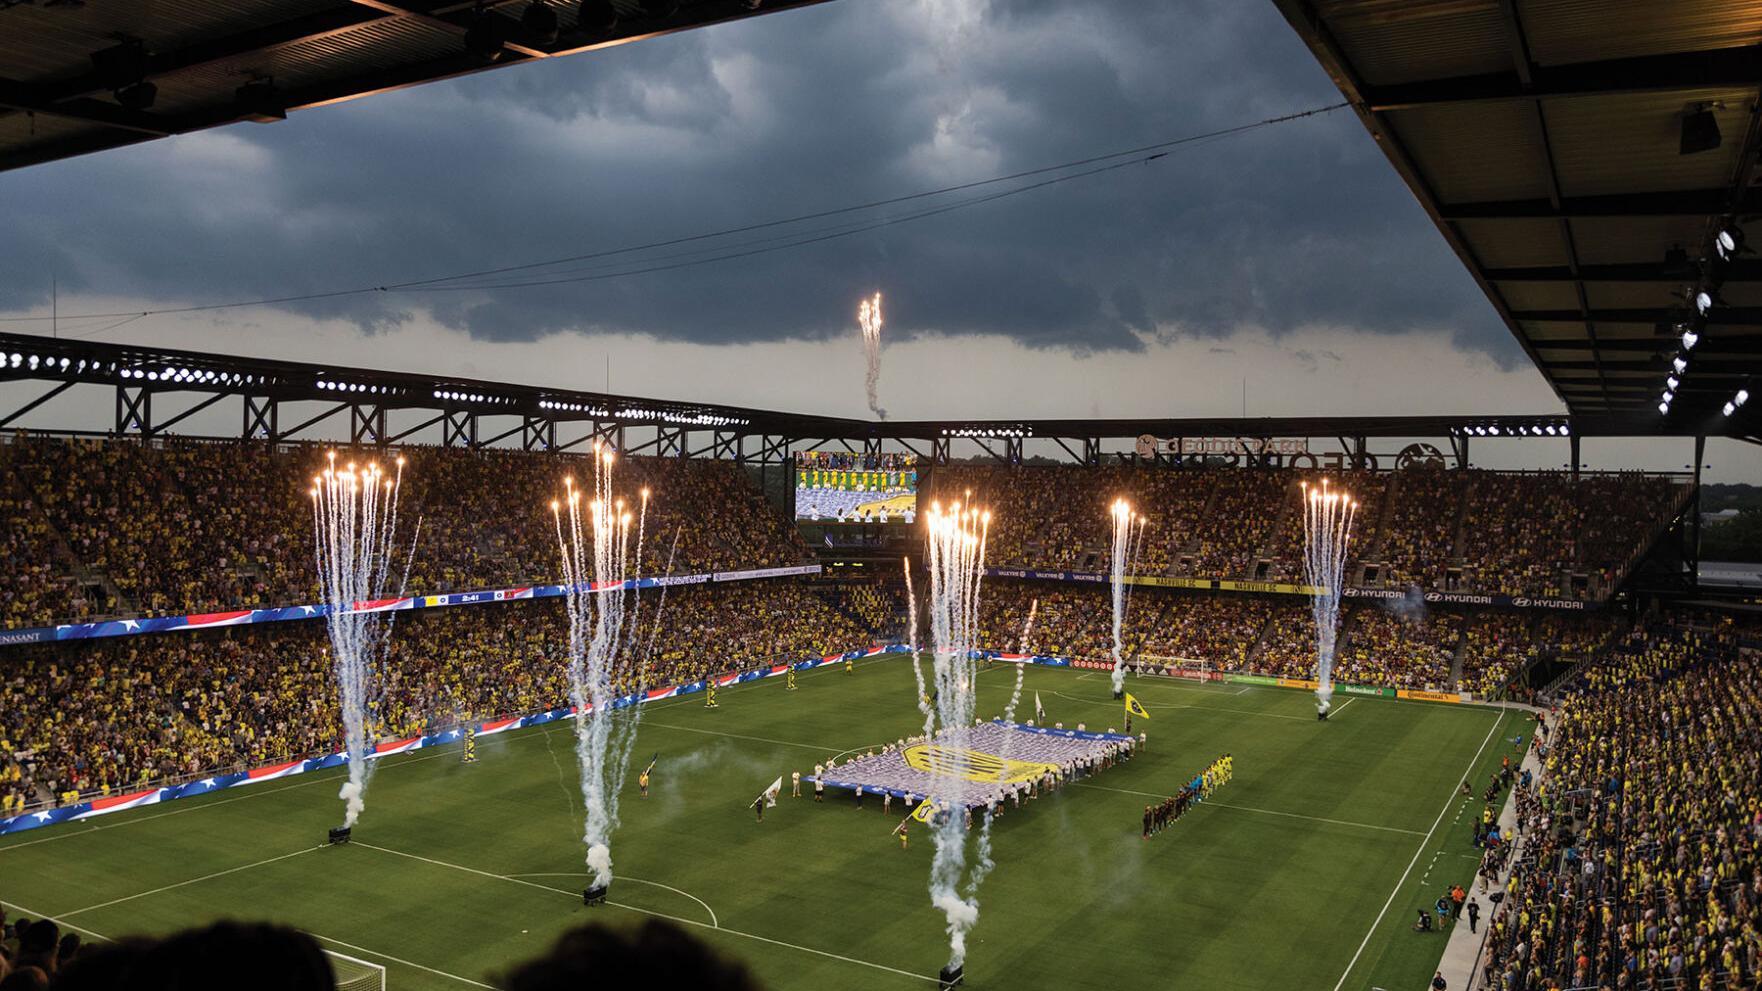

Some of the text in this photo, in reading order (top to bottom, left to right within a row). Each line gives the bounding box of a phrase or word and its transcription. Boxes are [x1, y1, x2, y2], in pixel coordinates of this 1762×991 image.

[1164, 438, 1308, 455] GEODIS PARK
[1361, 590, 1406, 599] HYUNDAI
[1444, 595, 1492, 604] HYUNDAI
[1533, 599, 1584, 609] HYUNDAI
[1345, 686, 1376, 694] Heineken
[1407, 691, 1444, 700] Continental
